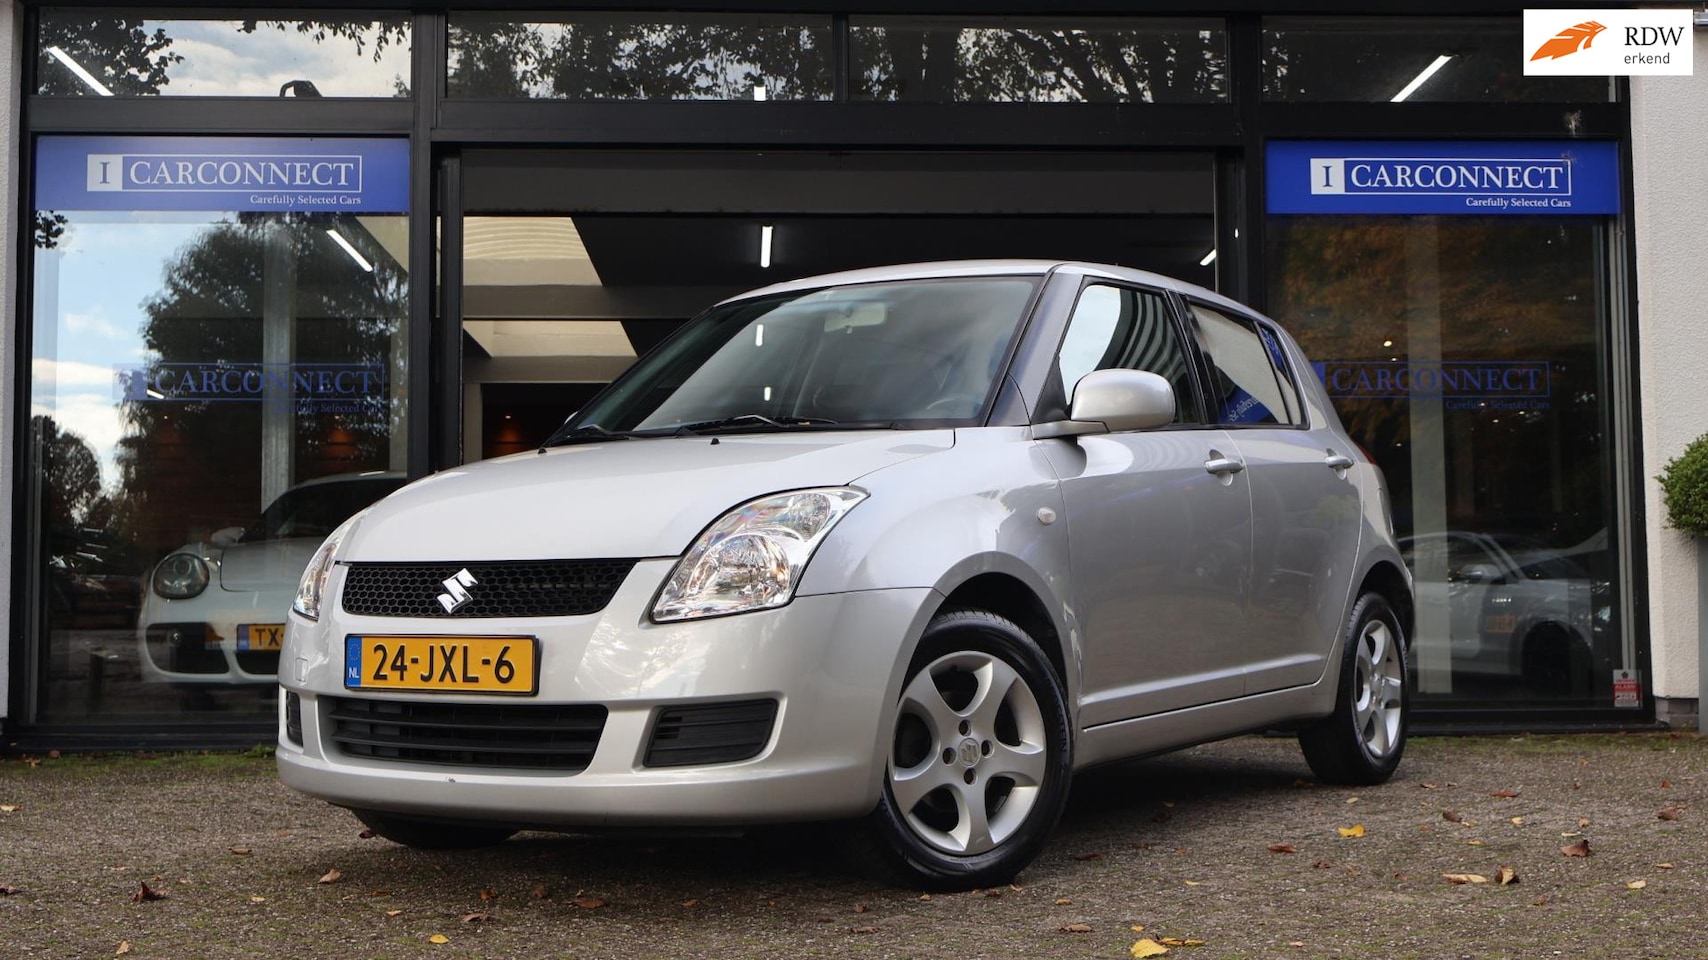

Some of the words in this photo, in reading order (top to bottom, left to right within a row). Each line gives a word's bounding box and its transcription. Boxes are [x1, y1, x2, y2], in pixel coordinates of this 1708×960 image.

[99, 161, 111, 185] I
[129, 161, 354, 186] CARCONNECT
[1322, 165, 1333, 188] I
[1350, 164, 1563, 189] CARCONNECT
[249, 194, 296, 207] Carefully
[297, 195, 337, 205] Selected
[339, 195, 362, 205] Cars
[1465, 197, 1509, 210] Carefully
[1510, 197, 1549, 208] Selected
[1550, 198, 1572, 208] Cars
[154, 369, 377, 395] CARCONNECT
[1331, 367, 1542, 392] CARCONNECT
[348, 666, 360, 678] NL
[372, 643, 516, 684] 24-JXL-6
